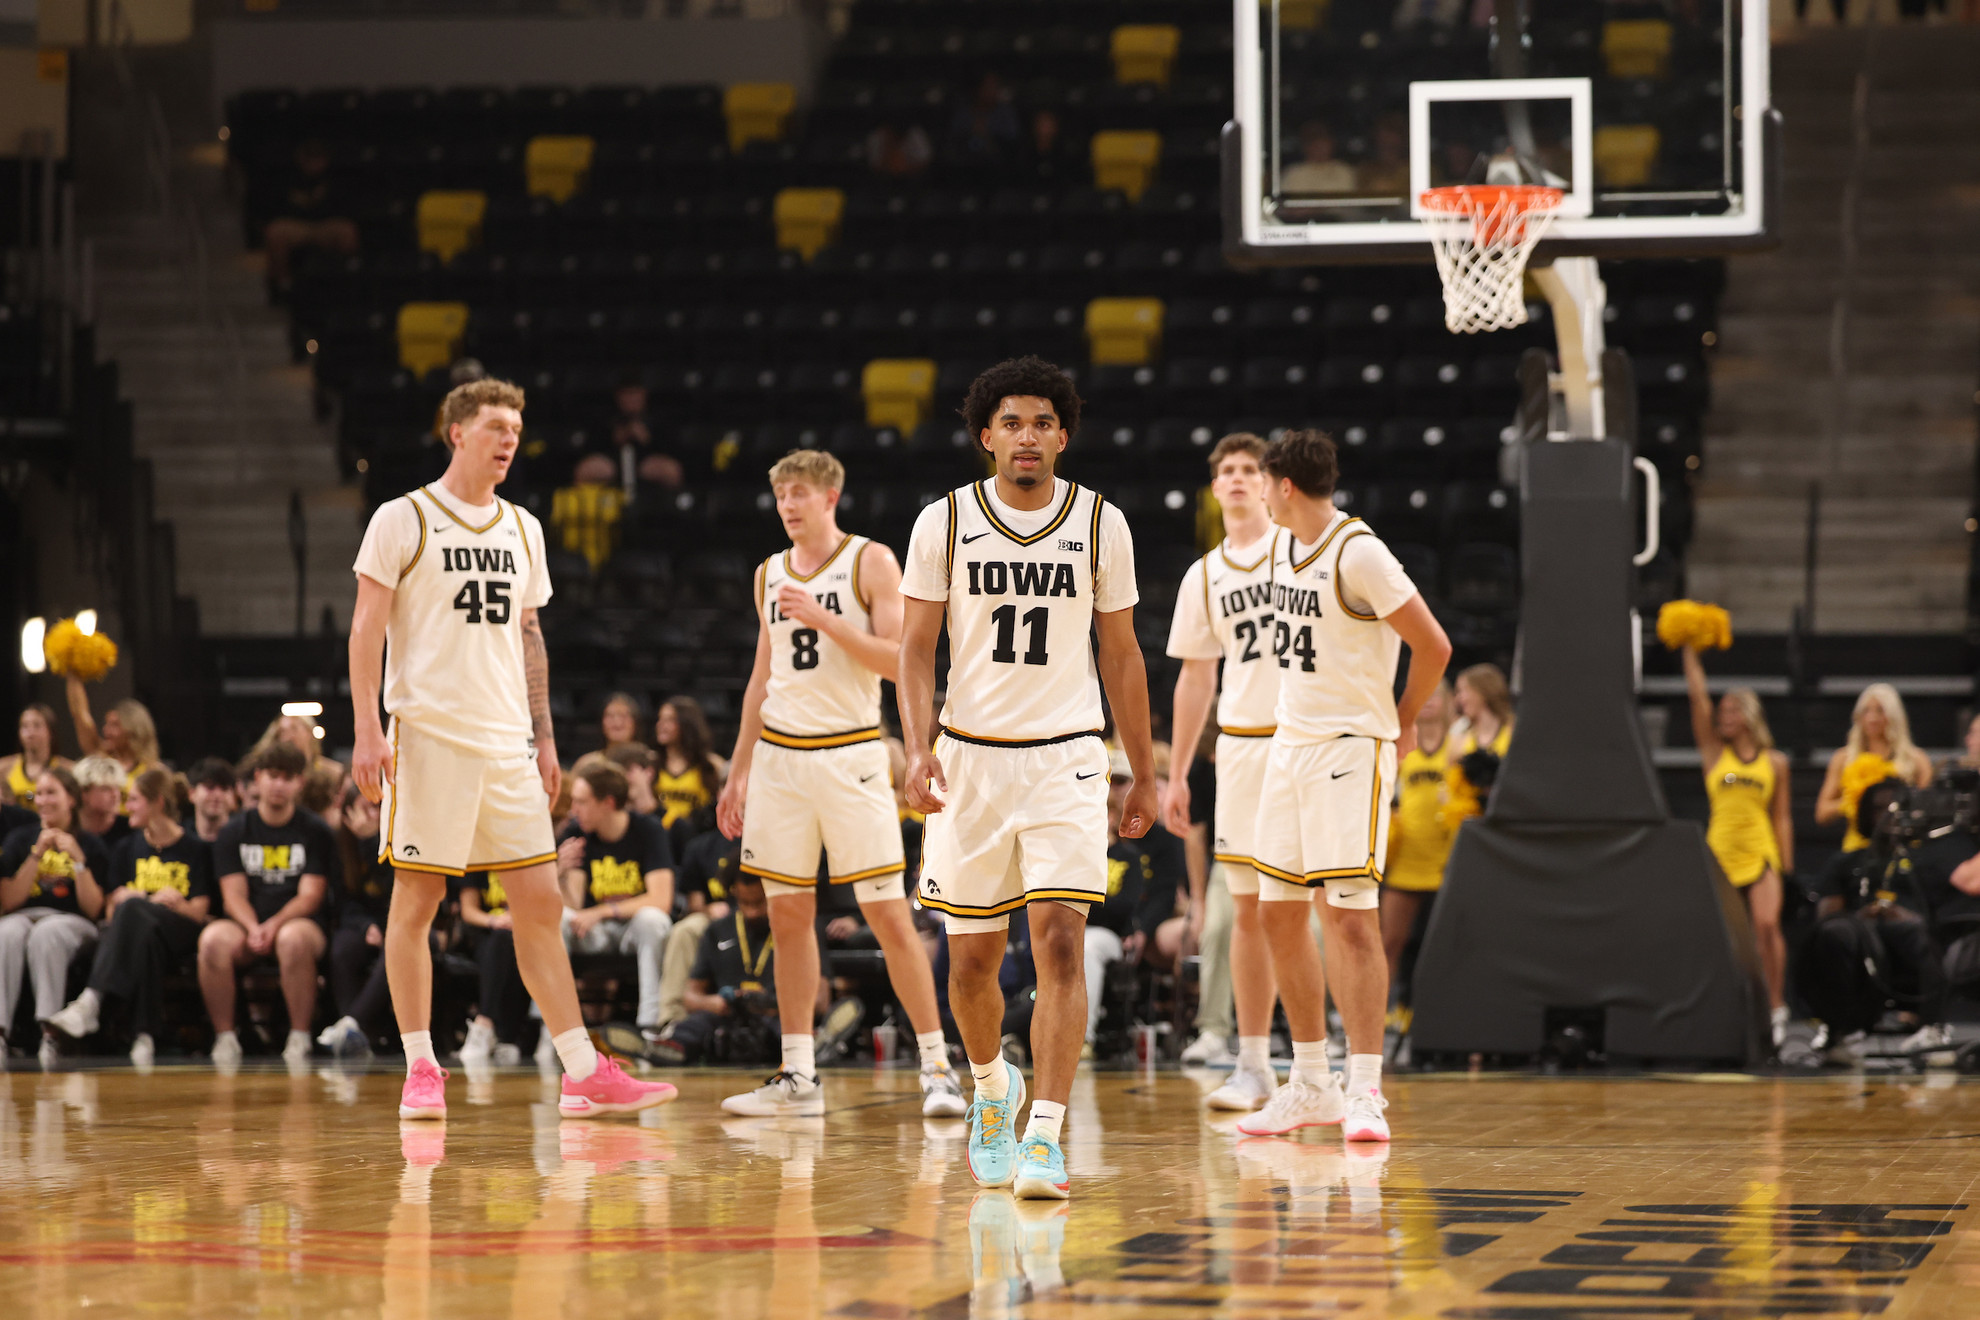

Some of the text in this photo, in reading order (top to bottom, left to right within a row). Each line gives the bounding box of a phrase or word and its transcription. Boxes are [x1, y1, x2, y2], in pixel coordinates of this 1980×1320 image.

[442, 547, 517, 575] IOWA
[967, 561, 1077, 598] IOWA
[453, 580, 511, 625] 45
[769, 591, 842, 625] IA
[1221, 581, 1273, 618] IOW
[1274, 583, 1322, 618] OWA
[791, 628, 819, 671] 8
[991, 604, 1049, 666] 11
[1273, 620, 1316, 672] 24
